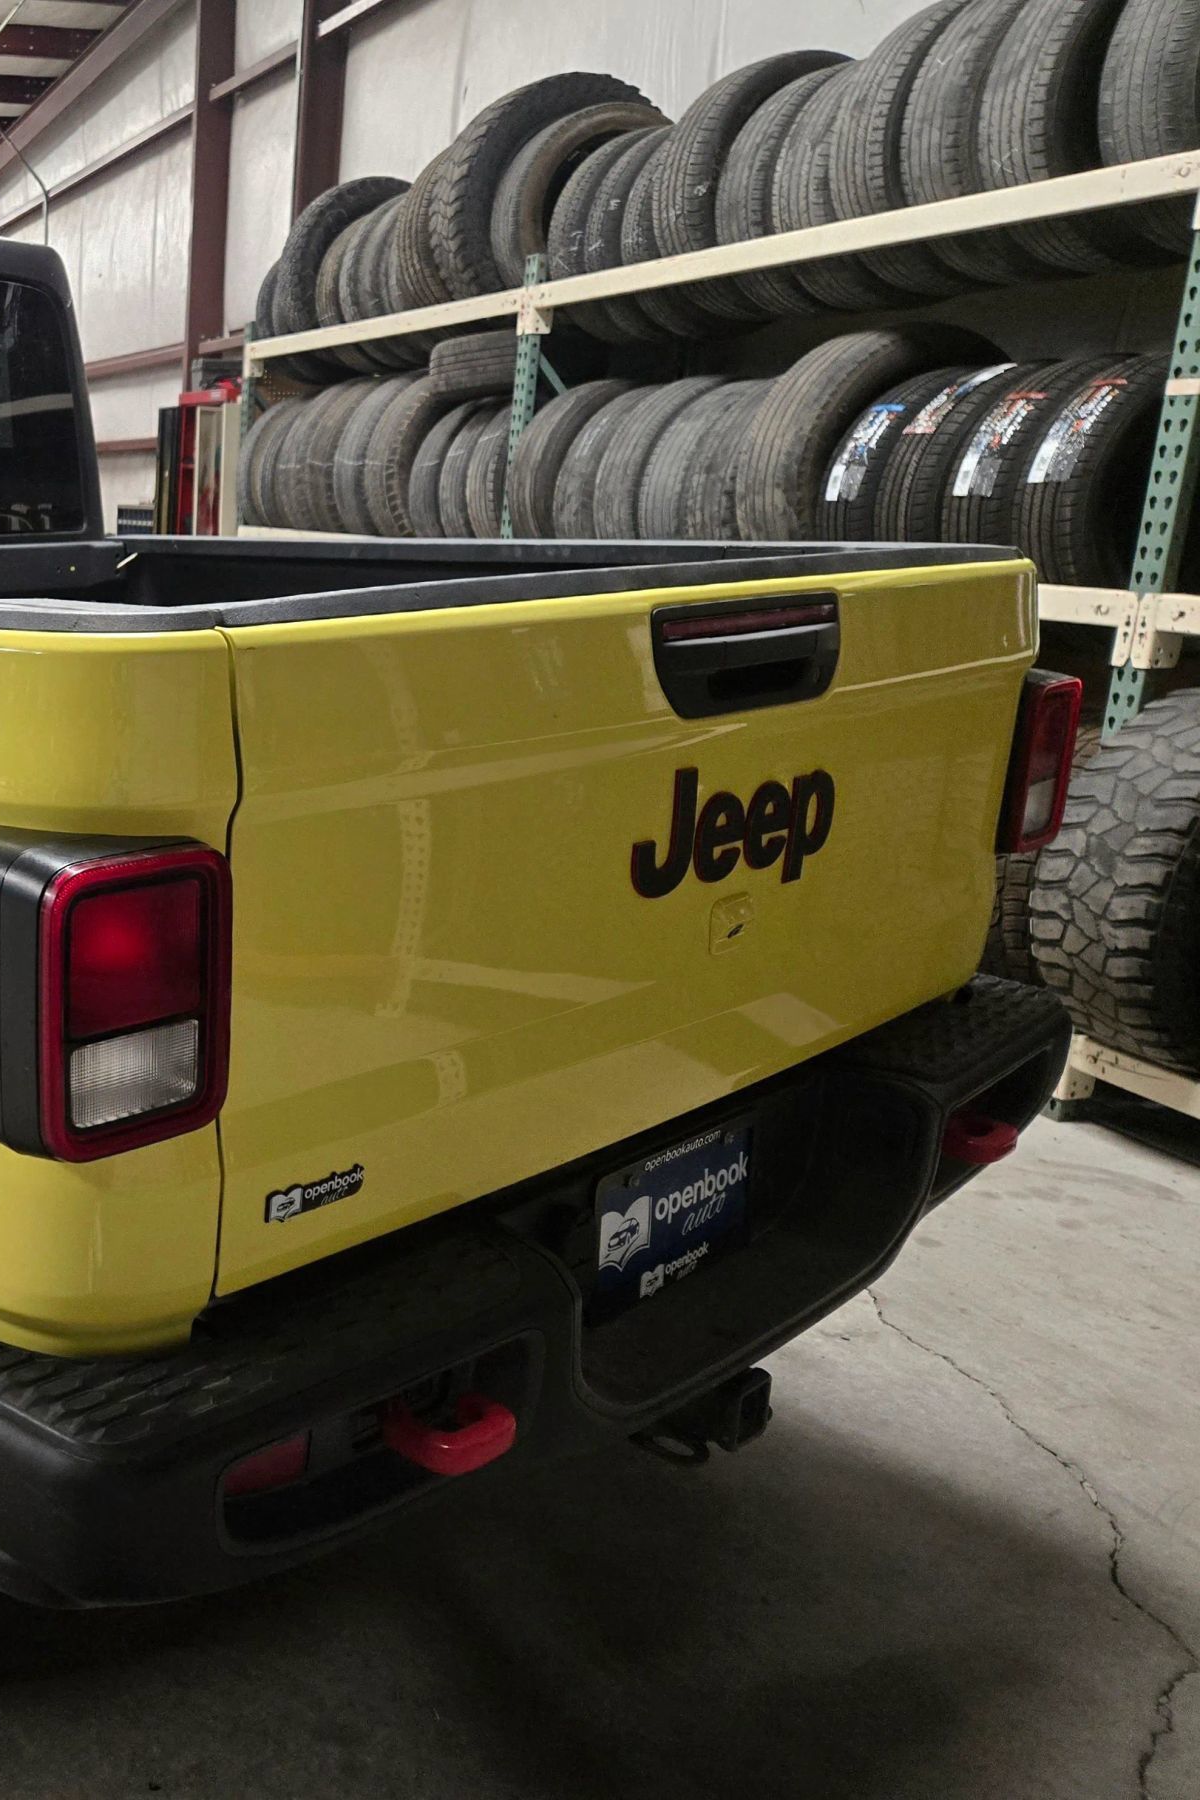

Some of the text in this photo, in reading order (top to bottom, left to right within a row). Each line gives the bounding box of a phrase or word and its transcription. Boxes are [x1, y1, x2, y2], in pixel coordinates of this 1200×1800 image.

[630, 766, 836, 899] Jeep
[644, 1129, 721, 1172] openbookauto.com
[304, 1167, 365, 1201] openbook
[654, 1151, 749, 1225] openbook
[680, 1191, 727, 1236] auto
[664, 1241, 710, 1276] openbook
